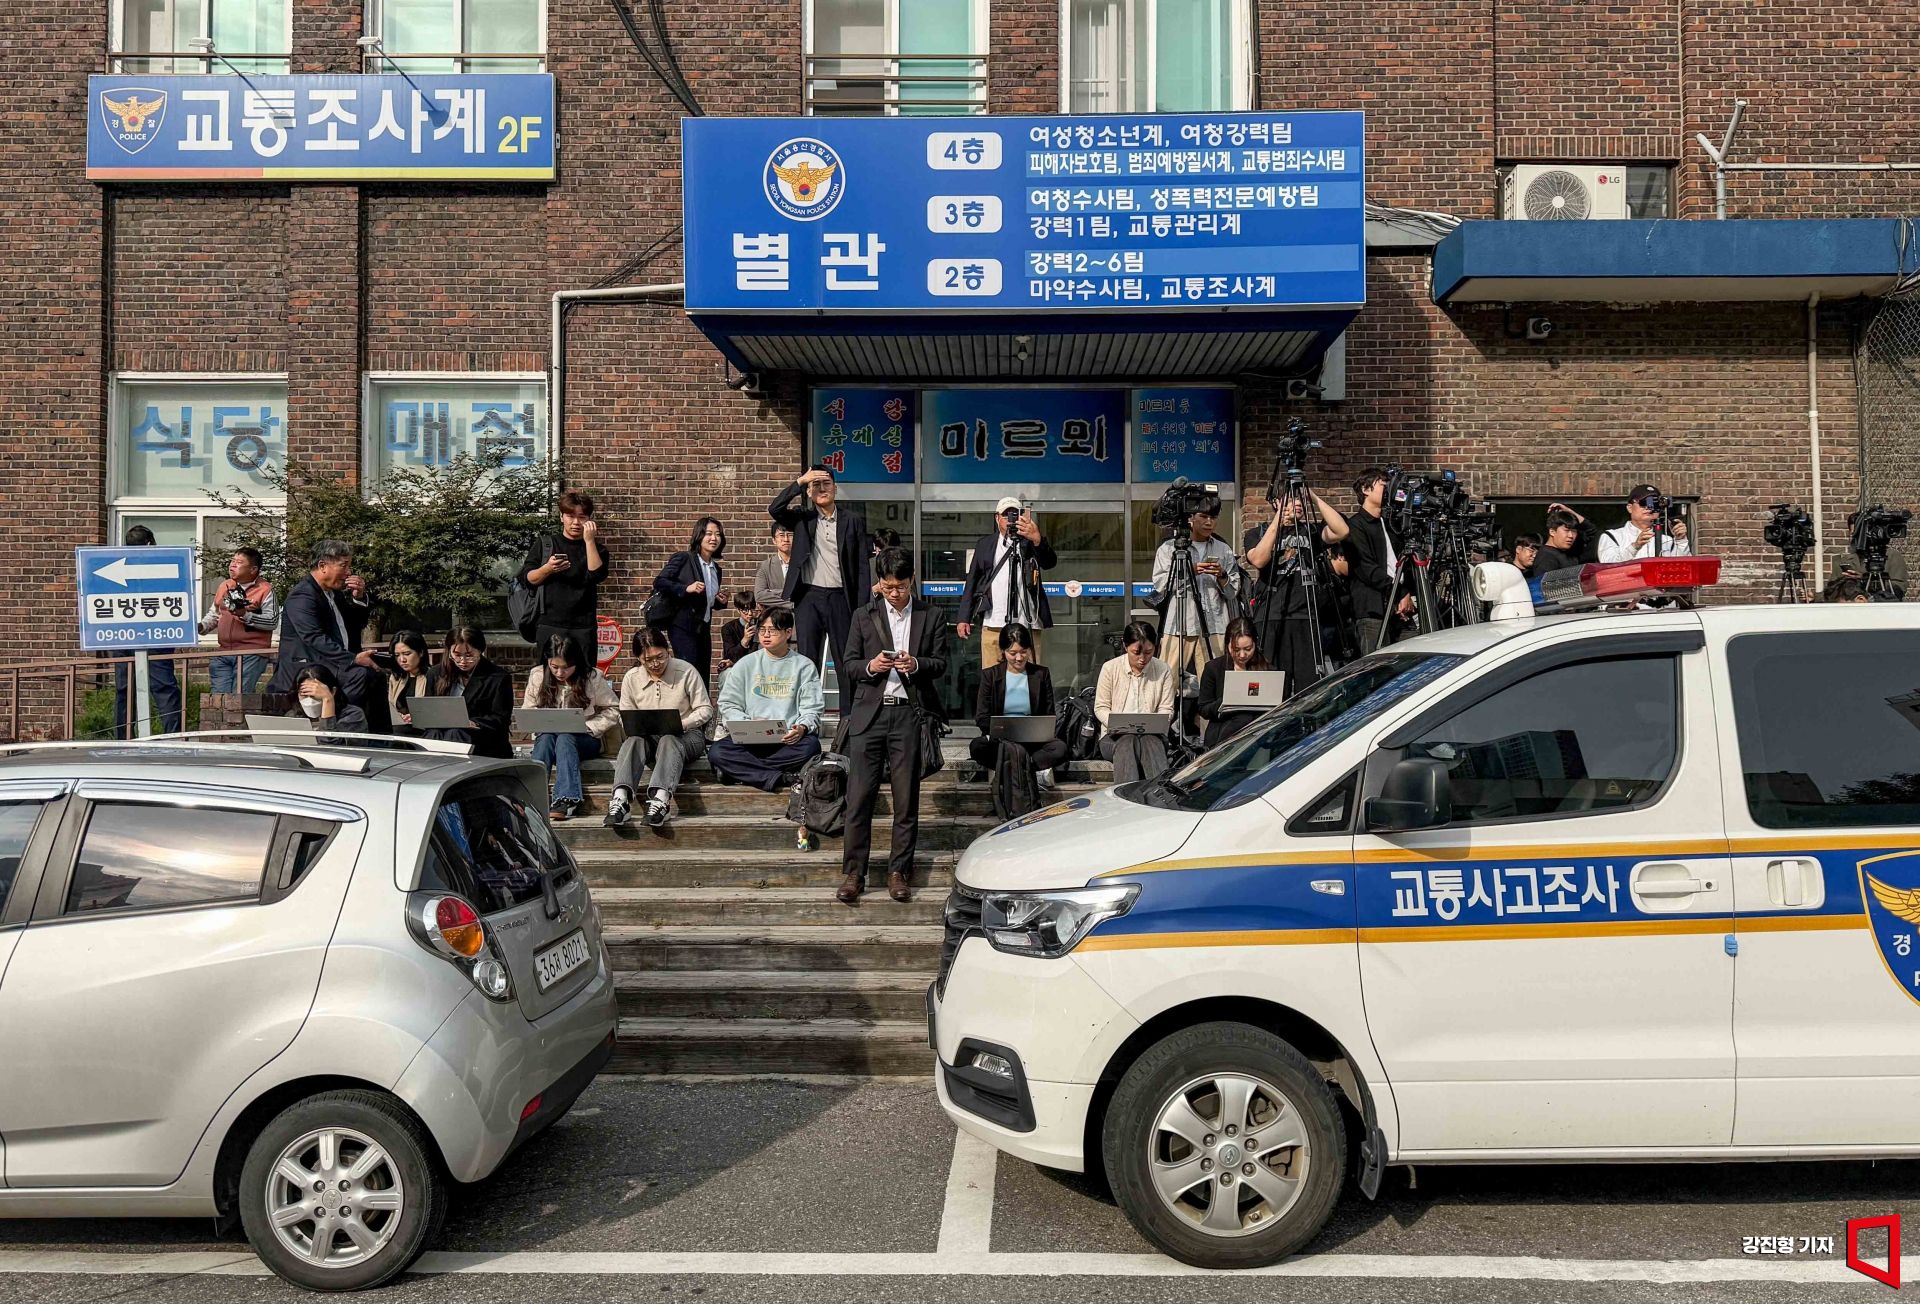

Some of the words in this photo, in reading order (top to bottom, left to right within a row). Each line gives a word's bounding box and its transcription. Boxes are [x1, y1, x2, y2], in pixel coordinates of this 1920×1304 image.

[177, 88, 485, 157] 교통조사계
[498, 116, 541, 153] 2F
[1029, 125, 1170, 149] 여성청소년계,
[1180, 122, 1292, 146] 여청강력팀
[119, 133, 147, 141] POLICE
[777, 143, 832, 161] 서울용산경찰서
[943, 138, 984, 164] 4층
[1030, 152, 1122, 175] 피해자보호팀,
[1128, 150, 1235, 174] 범죄예방질서계,
[1242, 149, 1345, 172] 교통범죄수사팀
[1609, 176, 1620, 184] LG
[769, 183, 781, 201] SEOUL
[779, 199, 806, 215] YONGSAN
[807, 203, 827, 215] POLICE
[826, 183, 840, 206] STATION
[1031, 187, 1141, 212] 여청수사팀,
[1150, 185, 1319, 210] 성폭력전문예방팀
[945, 201, 984, 227] 3층
[1030, 215, 1118, 239] 강력1팀,
[1128, 213, 1241, 237] 교통관리계
[1030, 251, 1144, 275] 강력2~6팀
[945, 264, 984, 290] 2층
[1030, 278, 1150, 301] 마약수사팀,
[1161, 276, 1276, 299] 교통조사계
[94, 597, 183, 618] 일방통행
[96, 627, 184, 641] 09:00~18:00
[1390, 865, 1620, 921] 교통사고조사
[562, 938, 585, 968] 8021
[1893, 934, 1910, 956] 경
